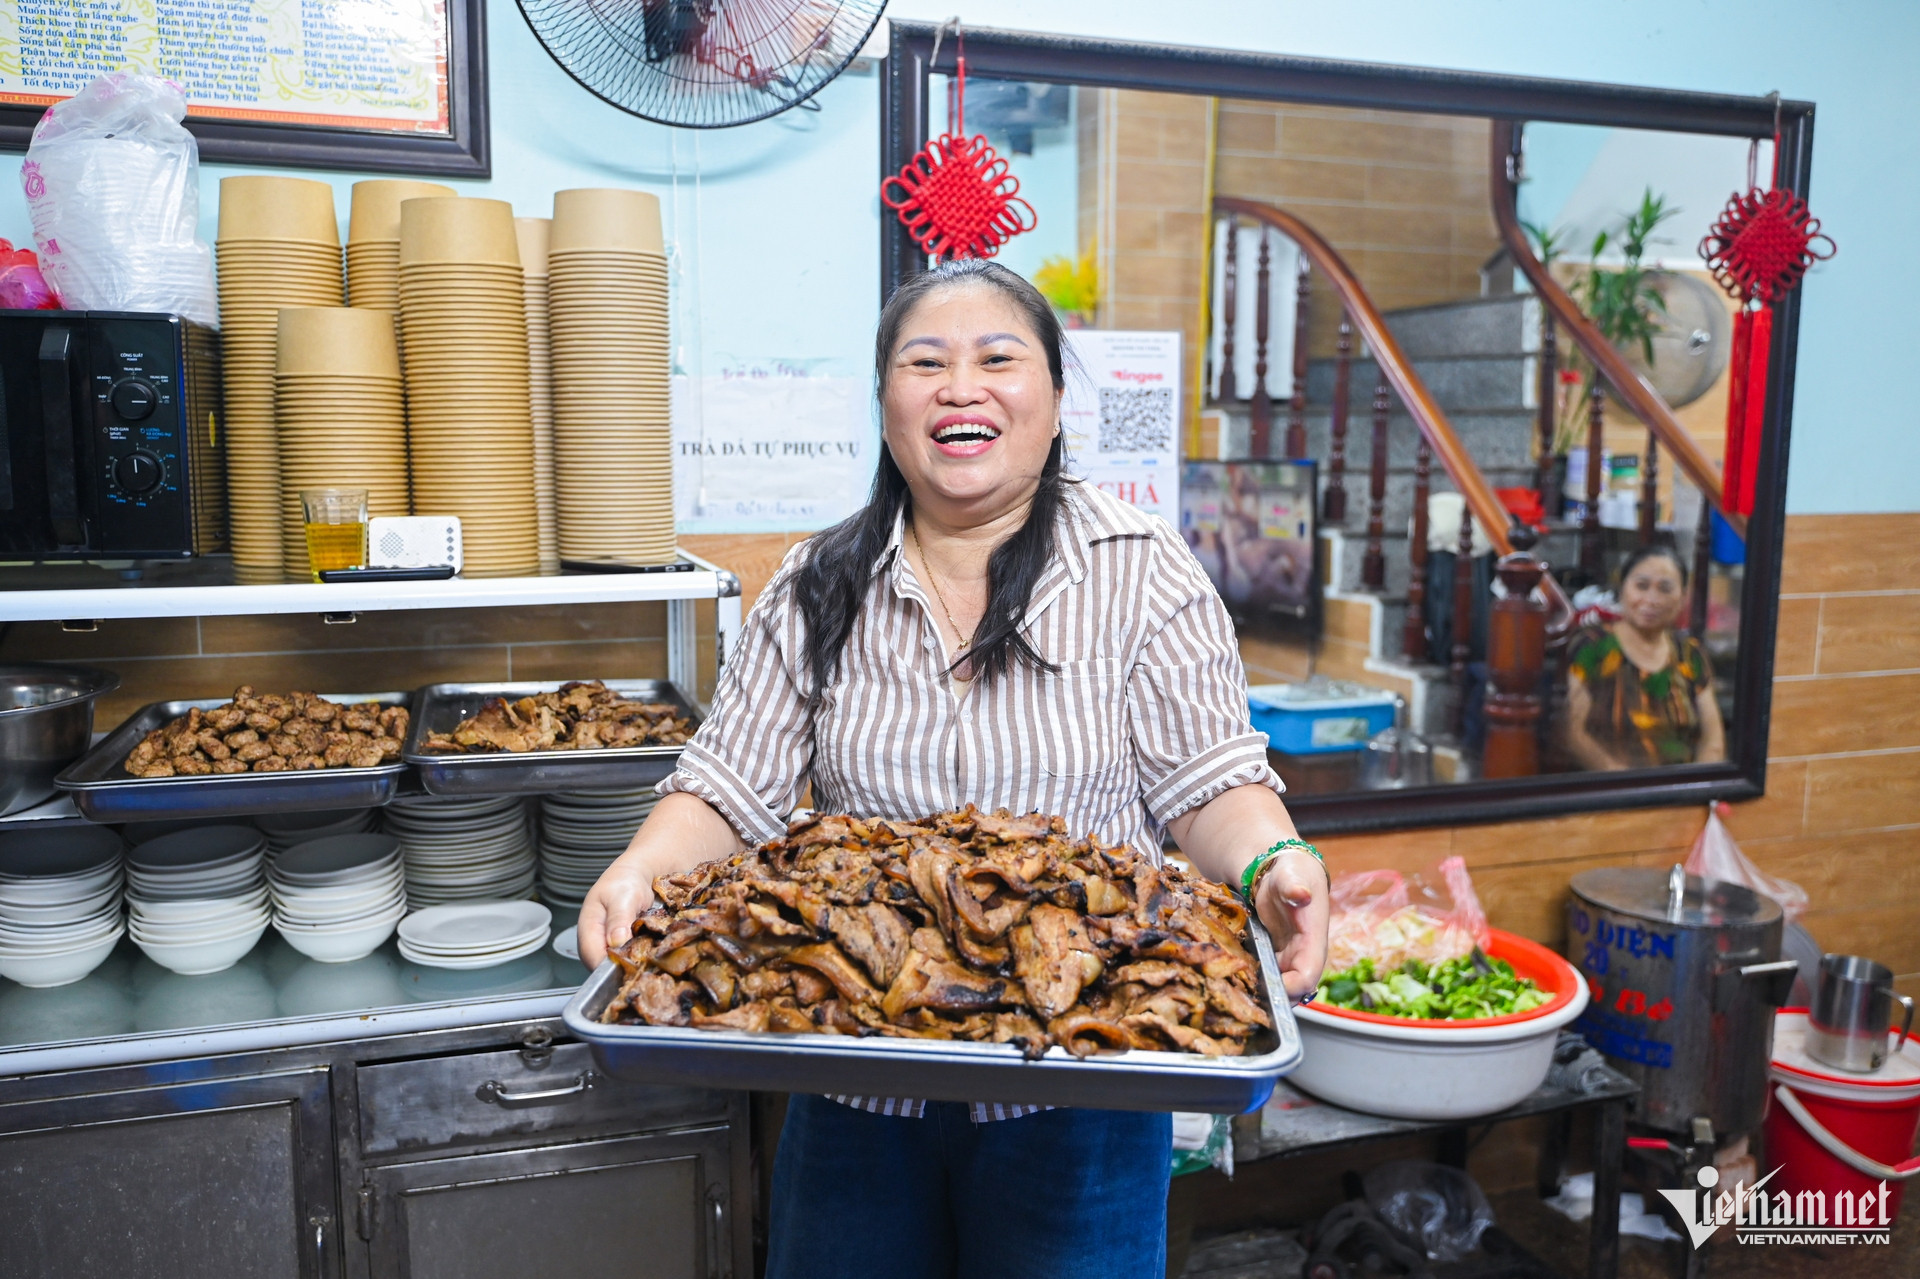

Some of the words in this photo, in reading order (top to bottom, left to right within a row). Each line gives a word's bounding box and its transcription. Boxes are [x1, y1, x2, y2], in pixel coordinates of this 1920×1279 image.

[73, 0, 86, 8] lúc
[111, 3, 121, 11] về
[18, 6, 46, 15] Muốn
[49, 7, 70, 16] hiểu
[73, 9, 90, 18] cần
[93, 10, 113, 21] lắng
[116, 14, 139, 23] nghe
[19, 16, 46, 24] Thích
[49, 18, 72, 27] khoe
[75, 20, 87, 29] thì
[91, 21, 102, 30] trí
[105, 25, 122, 33] cạn
[19, 26, 43, 36] Sống
[46, 29, 63, 38] dựa
[91, 33, 107, 42] ngu
[20, 37, 43, 46] Sống
[47, 38, 62, 47] bất
[85, 42, 102, 52] phá
[20, 47, 45, 57] Phận
[49, 49, 64, 58] bạc
[68, 51, 79, 59] dễ
[83, 52, 100, 60] bán
[104, 54, 127, 62] mình
[21, 57, 35, 66] Kẻ
[55, 60, 74, 69] chơi
[97, 62, 114, 72] bạn
[22, 68, 48, 76] Khốn
[52, 71, 70, 79] nạn
[22, 78, 39, 86] Tốt
[42, 80, 60, 89] đẹp
[63, 81, 80, 91] hãy
[678, 438, 716, 456] TRÀ
[722, 438, 746, 456] ĐÁ
[752, 440, 778, 459] TỰ
[783, 441, 831, 459] PHỤC
[836, 441, 860, 459] VỤ
